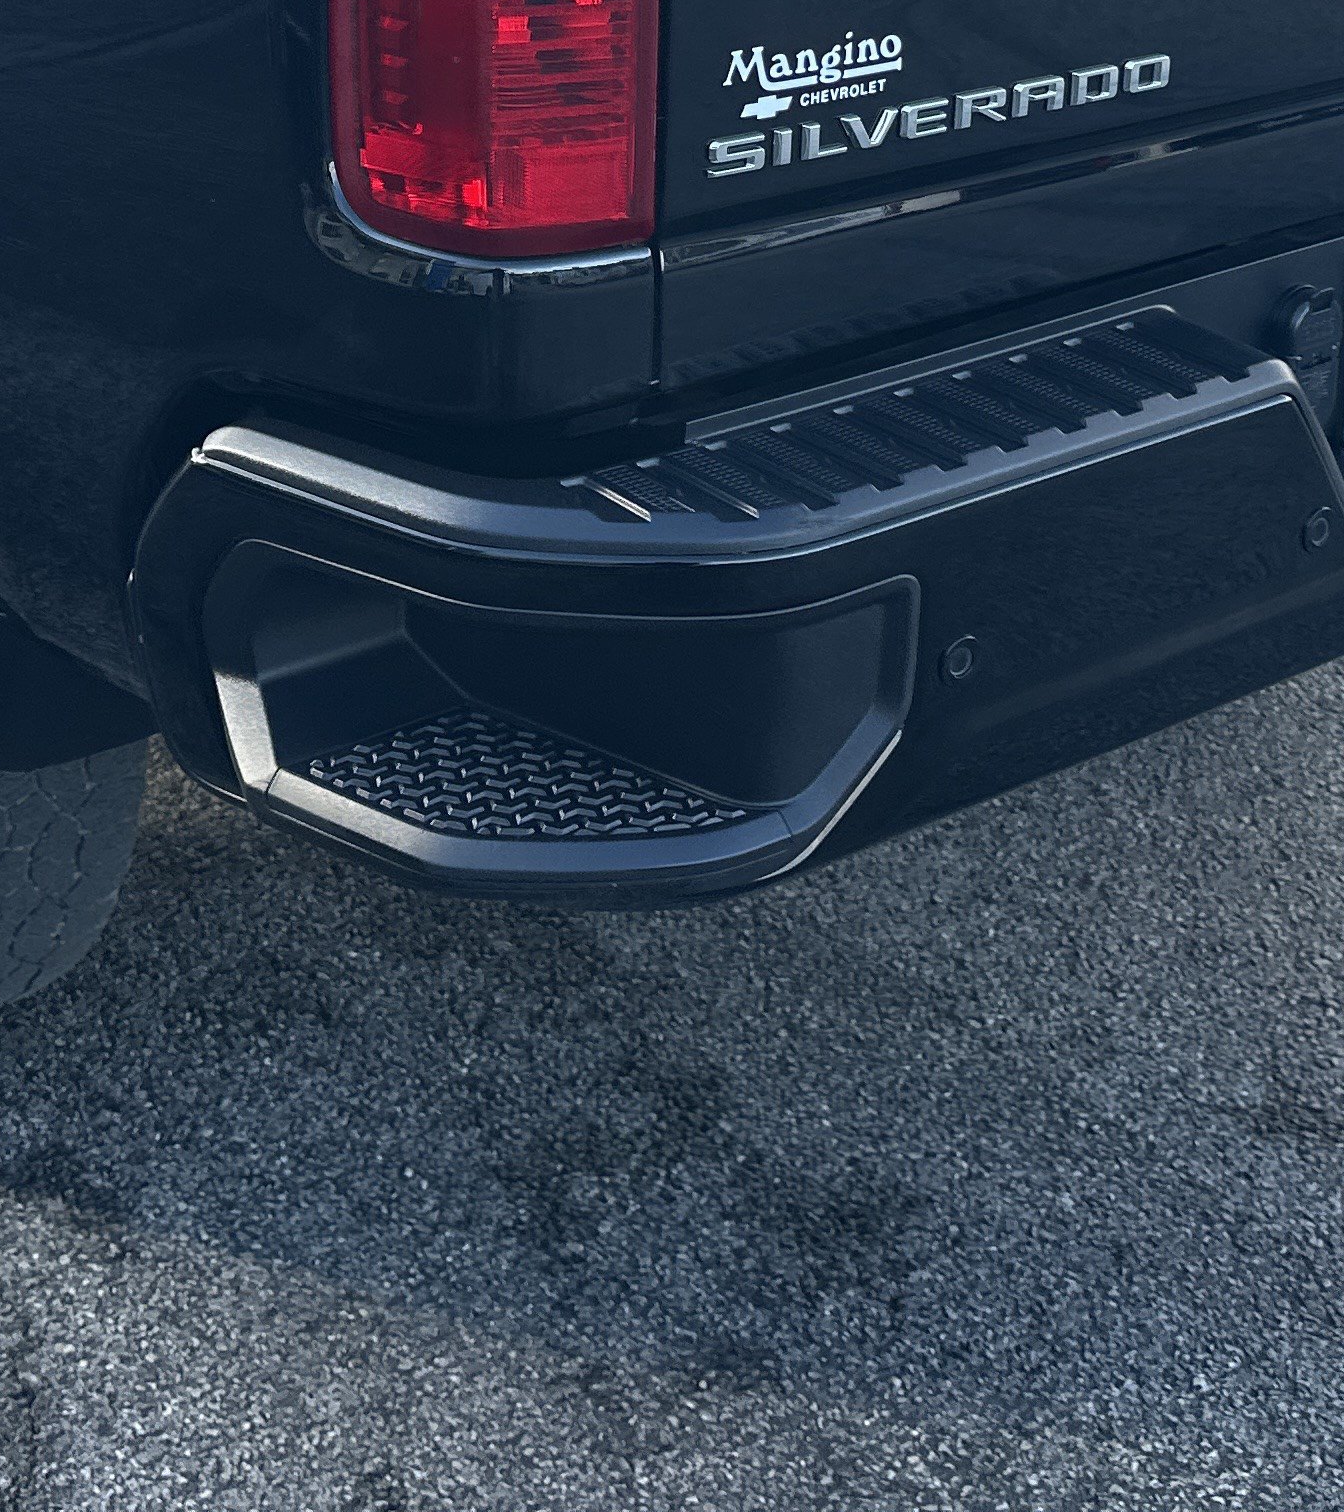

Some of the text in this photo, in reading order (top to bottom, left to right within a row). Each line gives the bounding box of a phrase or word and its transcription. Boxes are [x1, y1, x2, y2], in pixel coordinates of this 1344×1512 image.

[722, 31, 903, 90] Mangino
[706, 53, 1171, 178] SILVERADO
[799, 78, 887, 107] CHEVROLET
